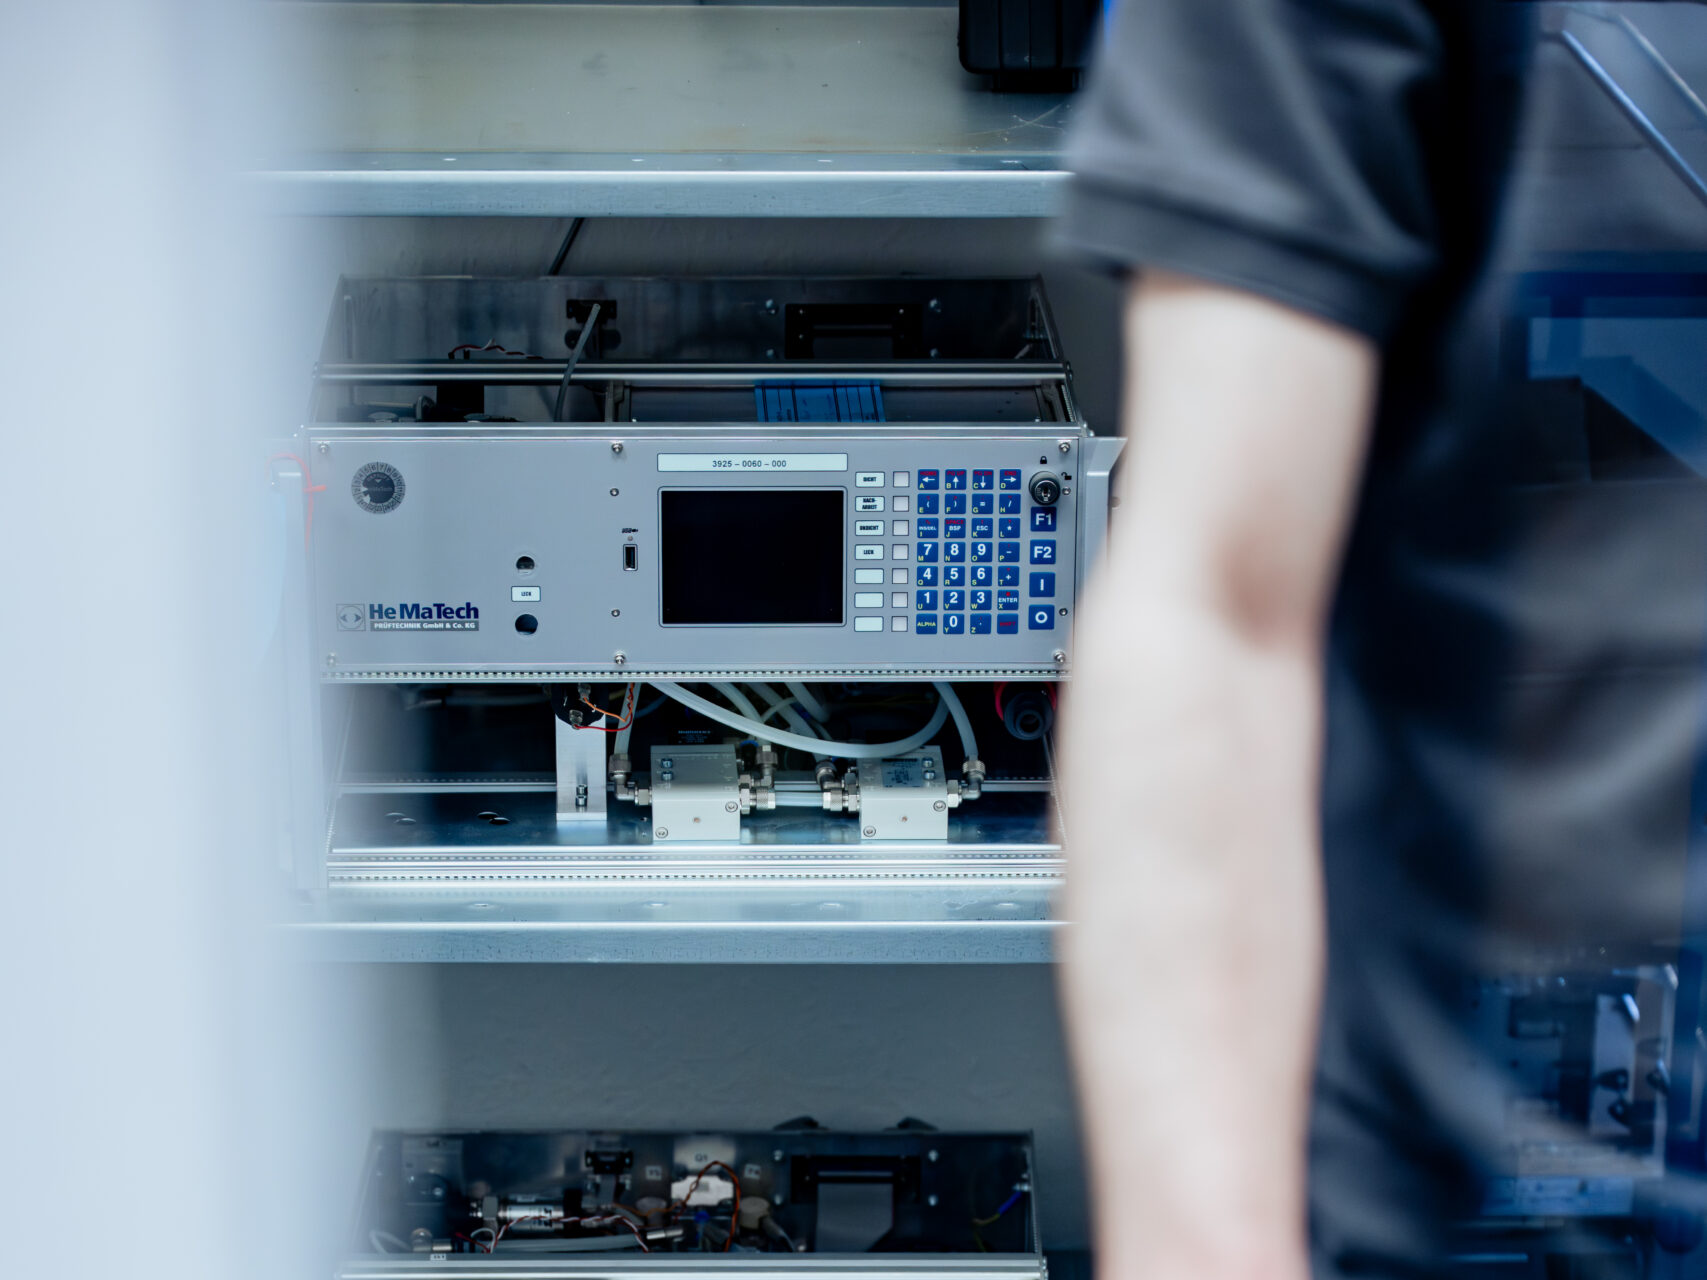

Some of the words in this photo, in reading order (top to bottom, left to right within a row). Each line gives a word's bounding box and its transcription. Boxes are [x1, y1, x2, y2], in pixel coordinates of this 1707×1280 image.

[1036, 513, 1052, 525] F1
[924, 544, 932, 555] 7
[951, 543, 959, 555] 8
[978, 544, 986, 555] 9
[1034, 546, 1052, 558] F2
[923, 568, 931, 579] 4
[950, 568, 958, 579] 5
[977, 568, 985, 579] 6
[924, 592, 930, 603] 1
[950, 592, 958, 603] 2
[977, 592, 985, 603] 3
[949, 616, 958, 627] 0
